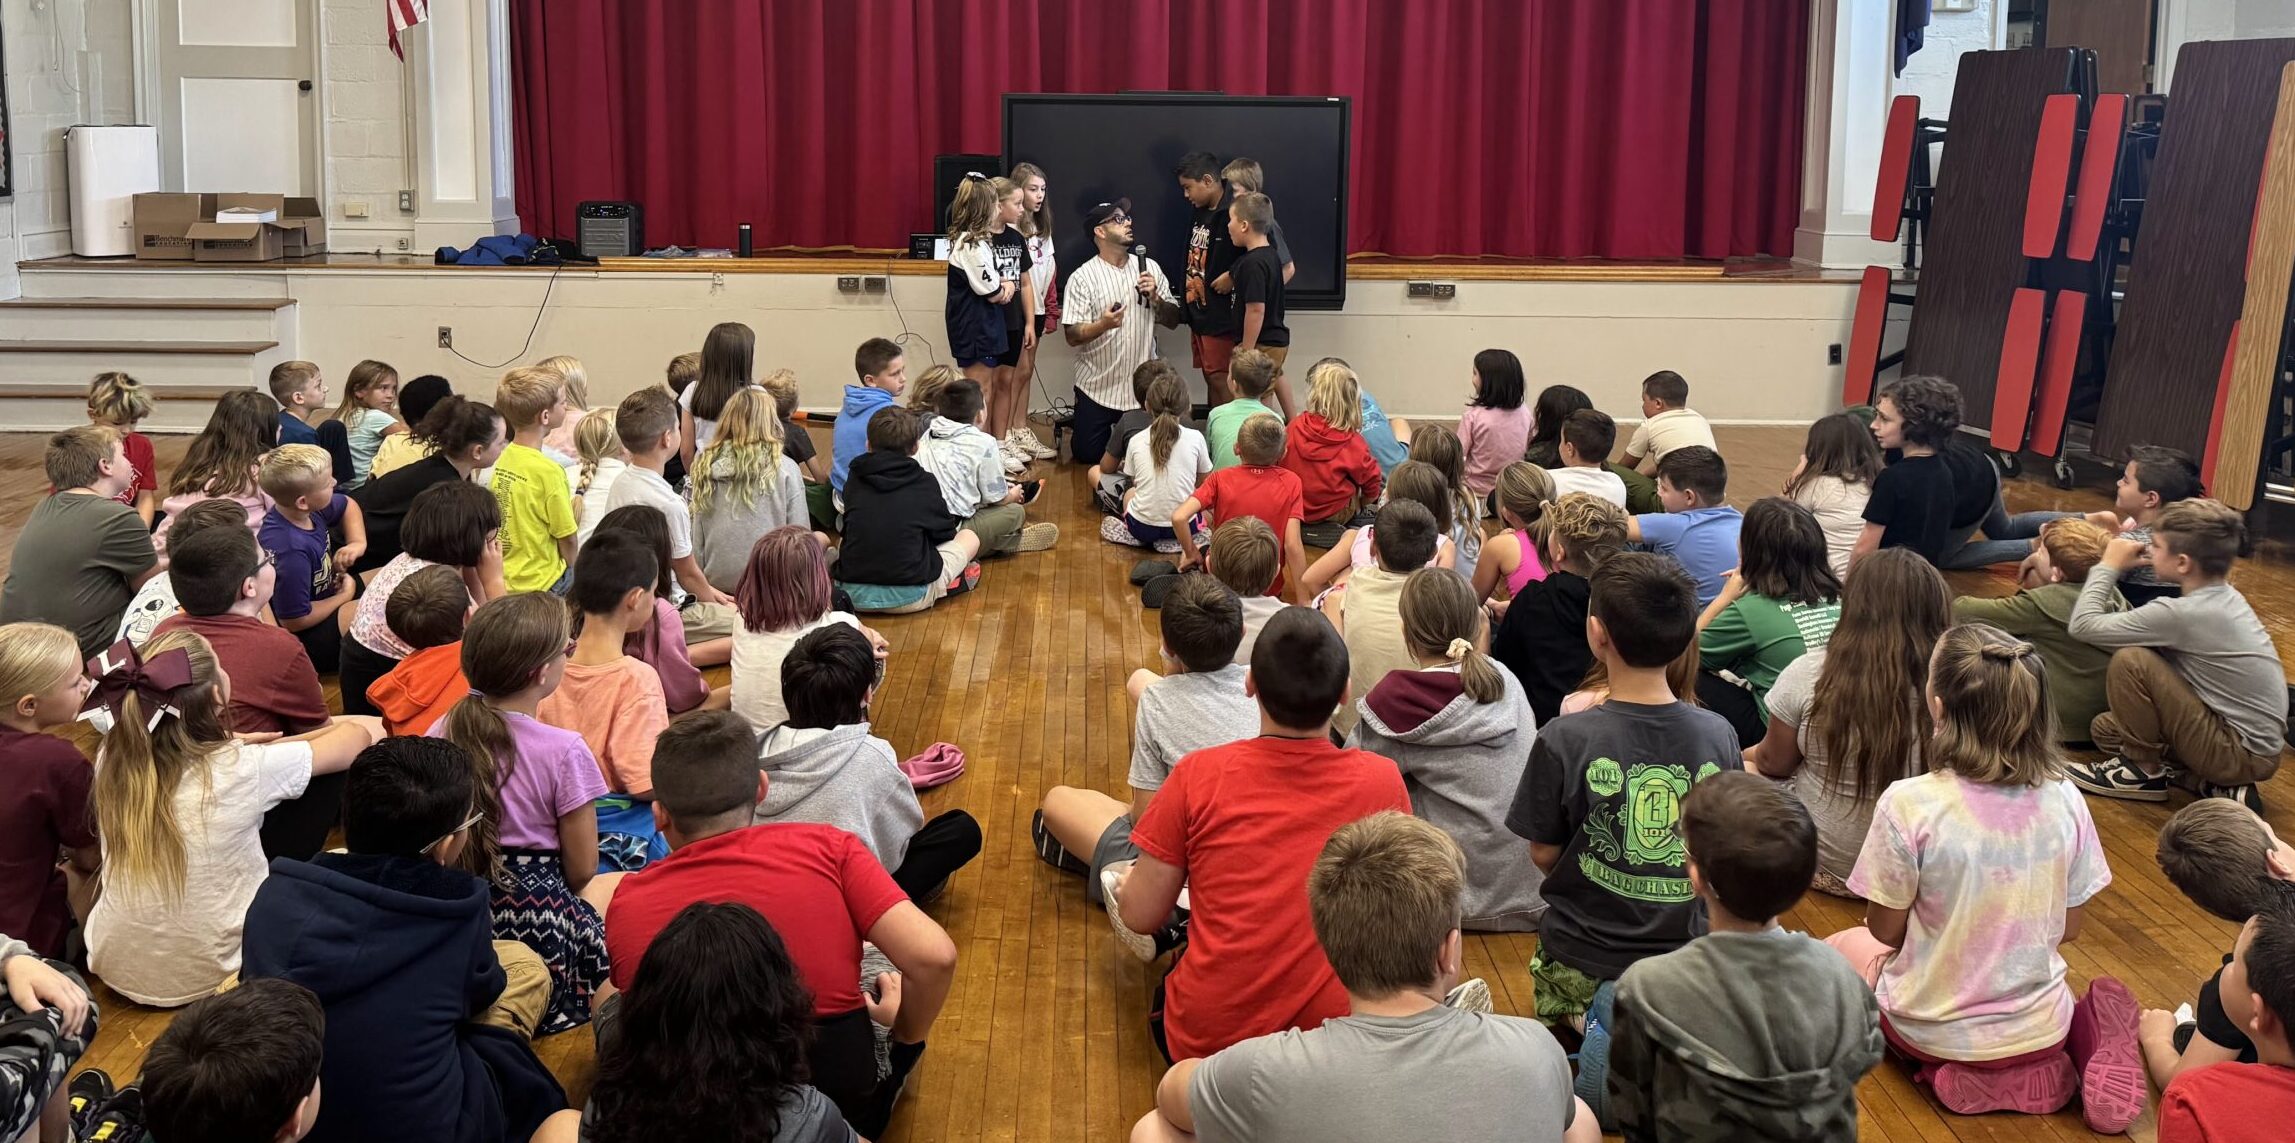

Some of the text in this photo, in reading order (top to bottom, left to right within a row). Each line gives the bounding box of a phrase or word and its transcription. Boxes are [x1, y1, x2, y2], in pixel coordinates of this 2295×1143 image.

[982, 270, 992, 283] 4
[97, 650, 127, 676] L
[1591, 769, 1618, 782] 101
[1643, 828, 1667, 837] 101
[1599, 867, 1695, 896] BAG CHASI
